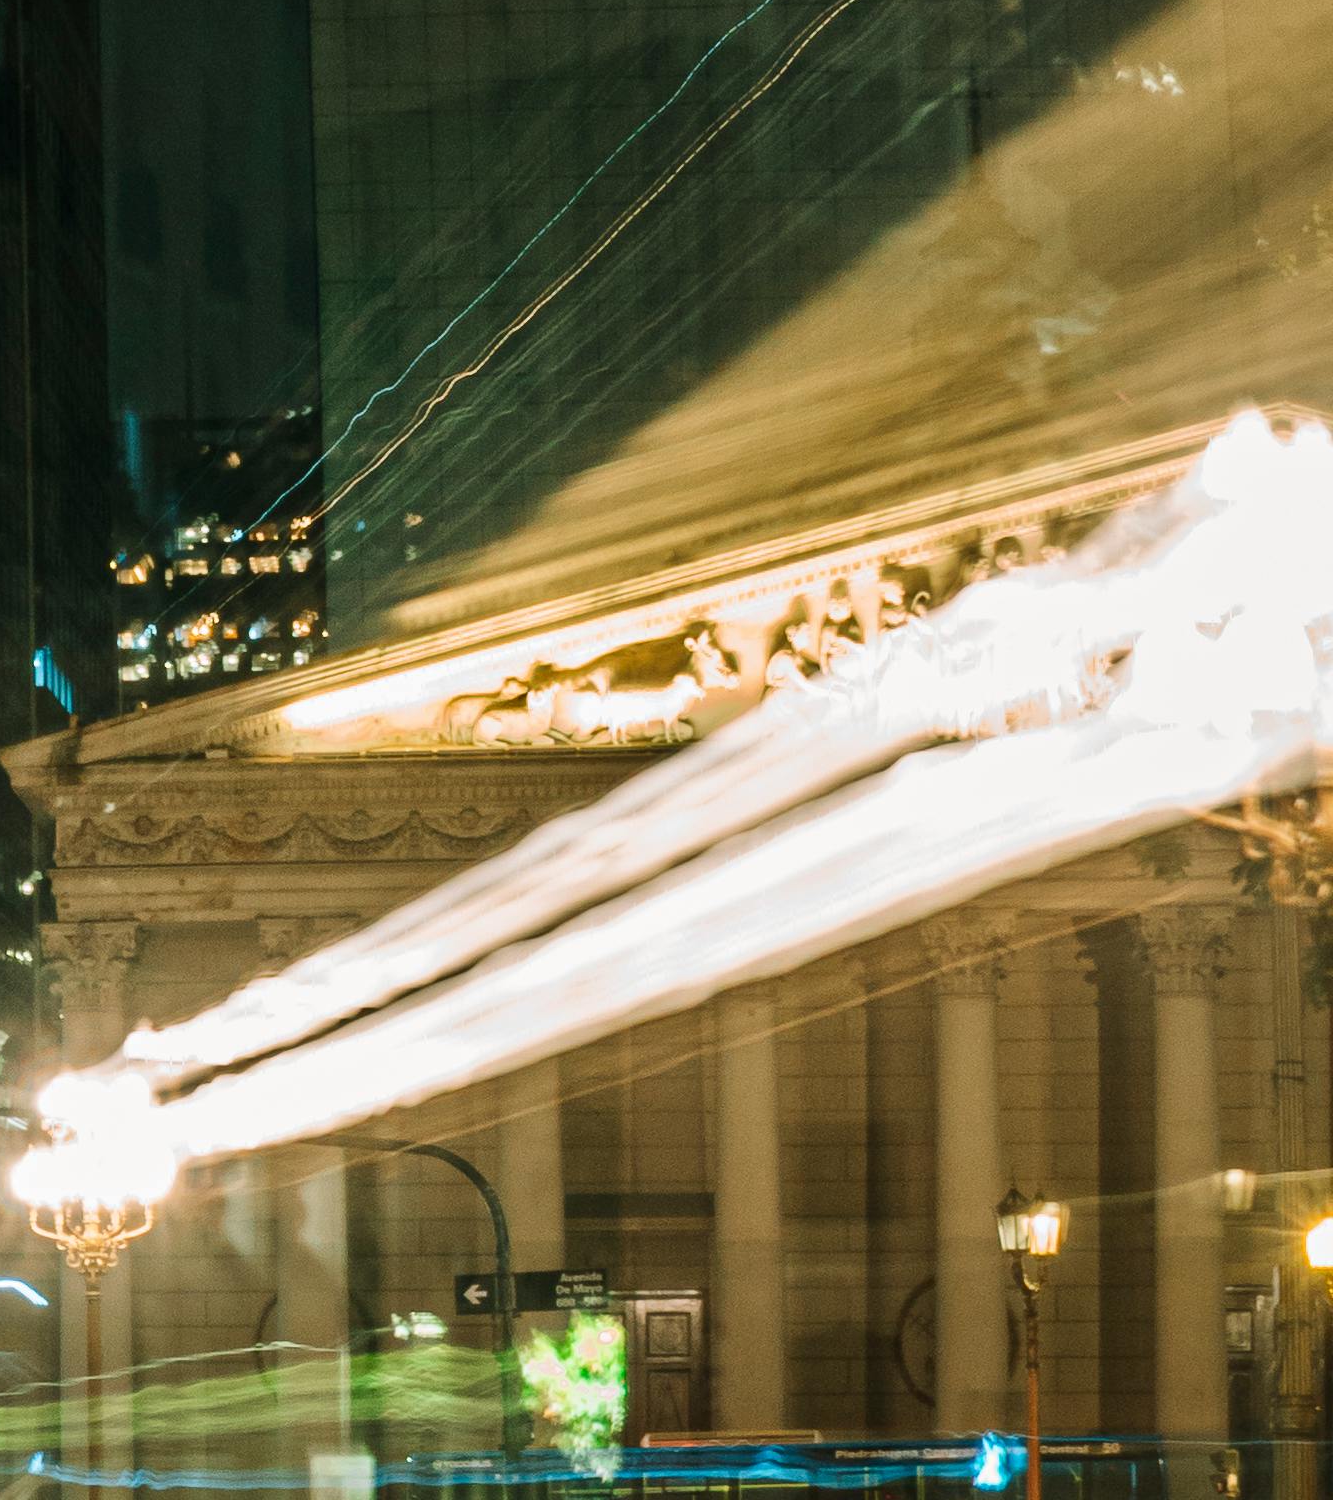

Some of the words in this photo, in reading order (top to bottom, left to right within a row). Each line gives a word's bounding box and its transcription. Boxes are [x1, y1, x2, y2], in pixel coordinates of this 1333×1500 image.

[561, 1272, 603, 1282] Avenida
[555, 1285, 571, 1295] De
[573, 1284, 603, 1295] Mayo
